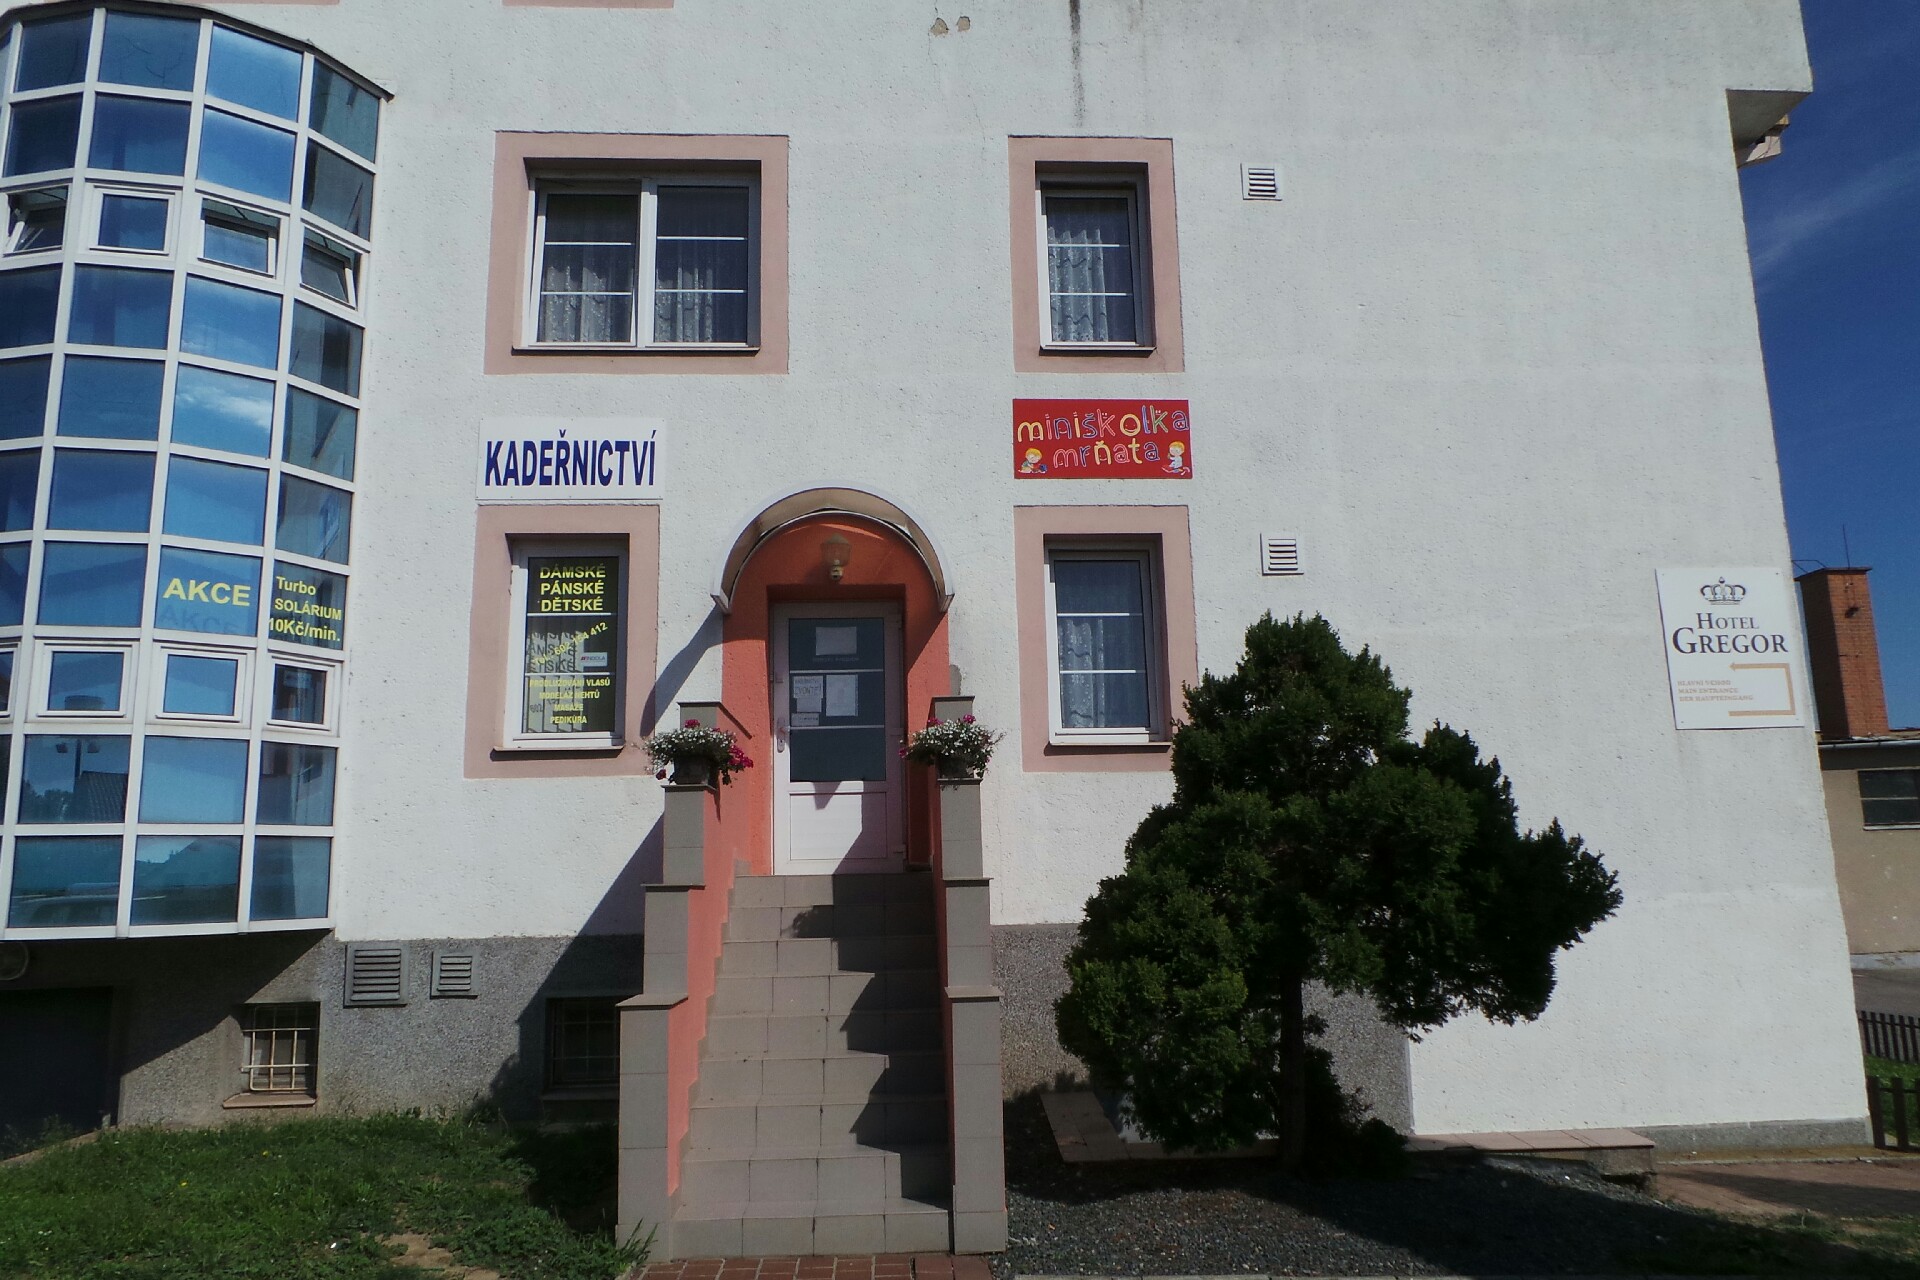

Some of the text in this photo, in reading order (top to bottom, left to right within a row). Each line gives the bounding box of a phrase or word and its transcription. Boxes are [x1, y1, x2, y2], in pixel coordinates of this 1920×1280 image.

[484, 429, 657, 487] KADEŘNICTVÍ
[1053, 437, 1161, 469] mrňata
[539, 563, 606, 579] DÁMSKÉ
[162, 577, 251, 607] AKCE
[276, 576, 317, 596] Turbo
[540, 580, 604, 596] PÁNSKÉ
[274, 597, 342, 621] SOLÁRIUM
[540, 596, 604, 612] DĚTSKÉ
[269, 617, 341, 642] 10Kč/min.
[590, 622, 609, 636] 412
